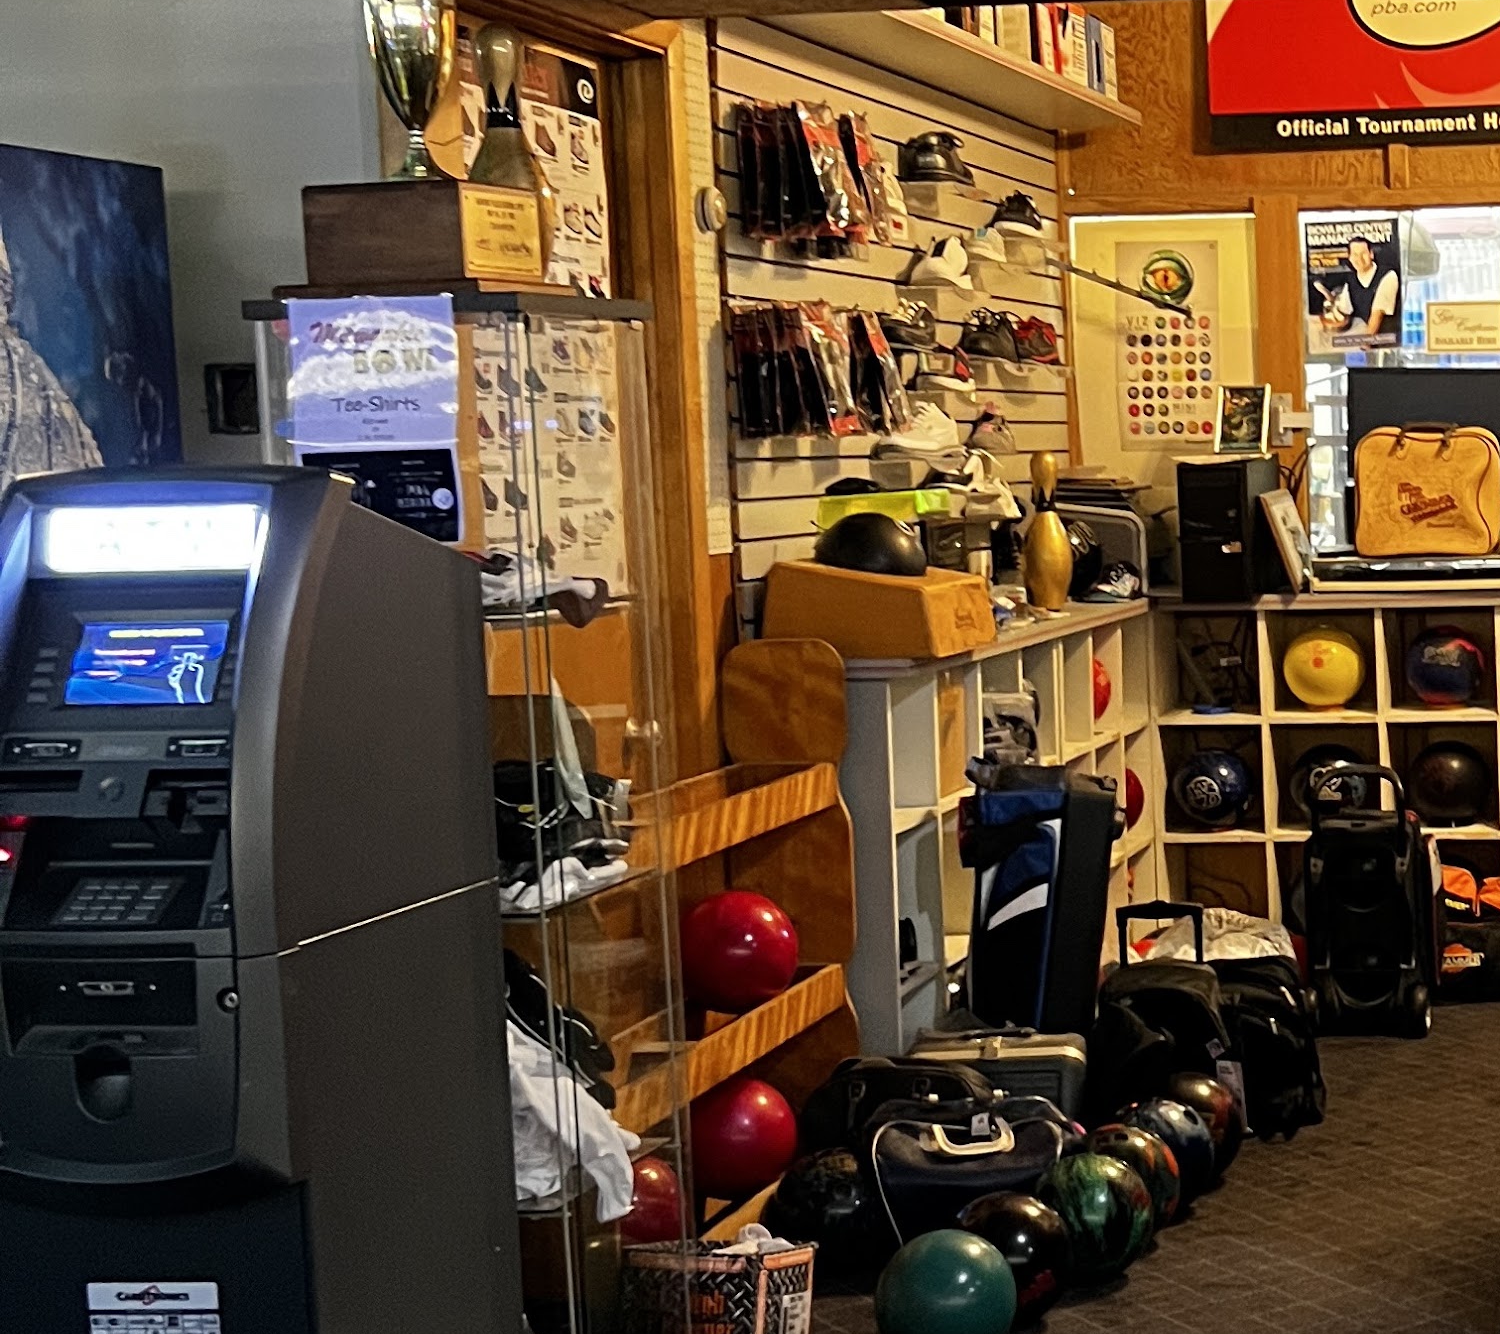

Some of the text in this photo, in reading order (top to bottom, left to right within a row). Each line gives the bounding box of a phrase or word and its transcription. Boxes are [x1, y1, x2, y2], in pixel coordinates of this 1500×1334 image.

[1371, 0, 1457, 17] pba.com
[1277, 118, 1350, 137] Official
[1356, 114, 1477, 134] Tournament
[330, 396, 421, 413] Tee-Shirts
